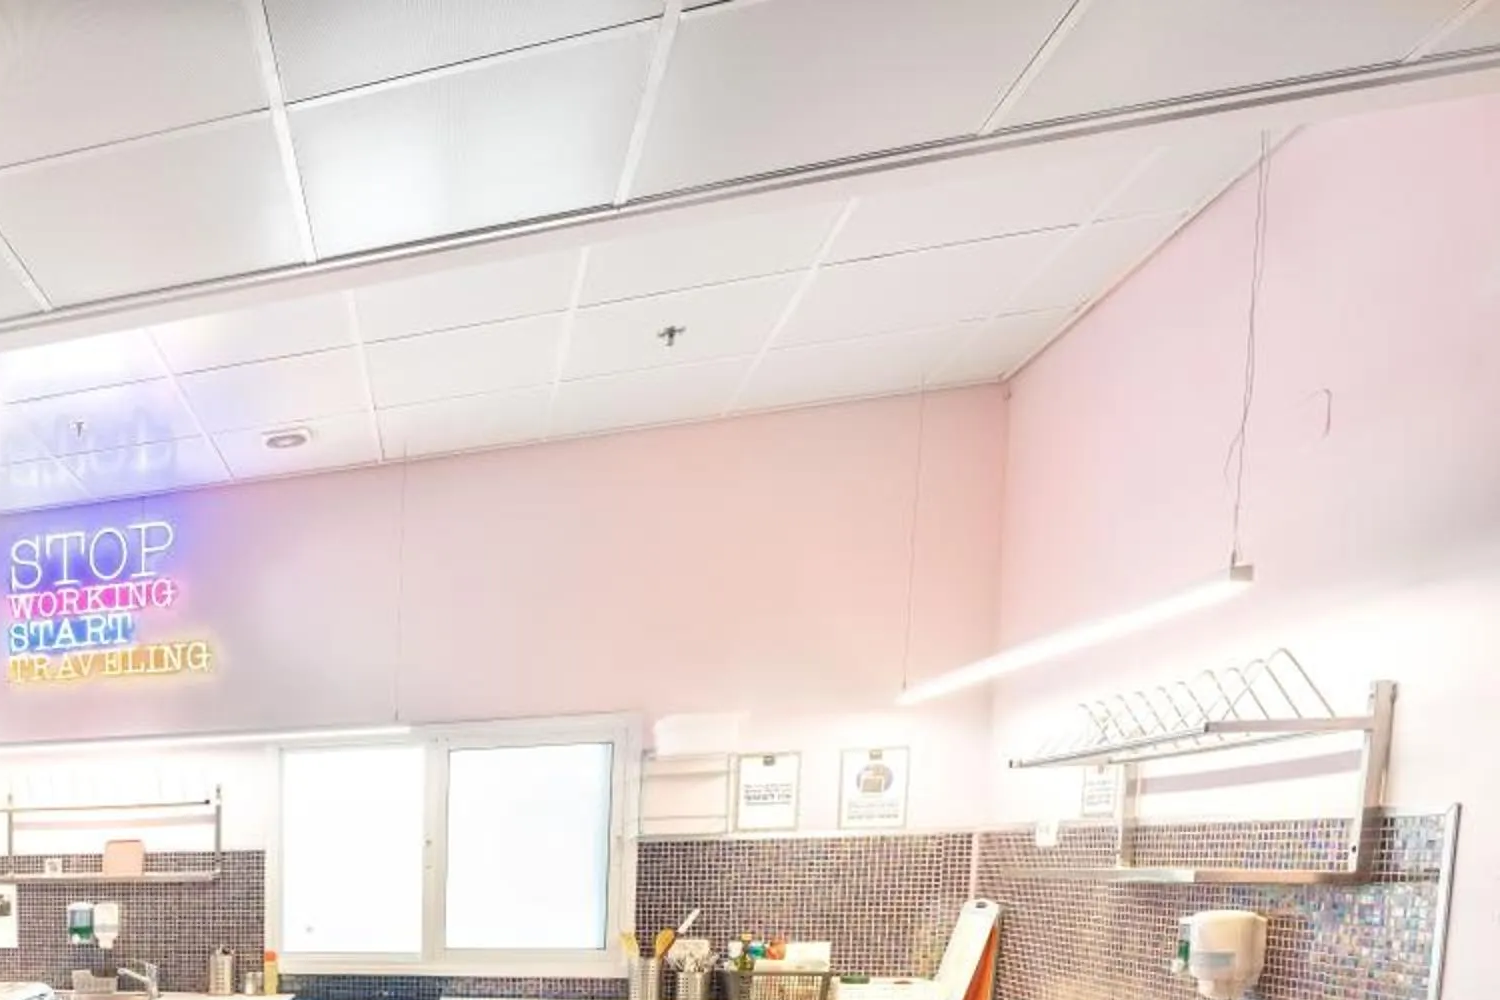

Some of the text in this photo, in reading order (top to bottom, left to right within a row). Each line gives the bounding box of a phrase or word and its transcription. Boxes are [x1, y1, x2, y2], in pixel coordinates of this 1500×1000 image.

[10, 521, 174, 591] STOP
[7, 578, 176, 619] WORKING
[9, 611, 133, 653] START
[9, 641, 212, 682] TRAVELING
